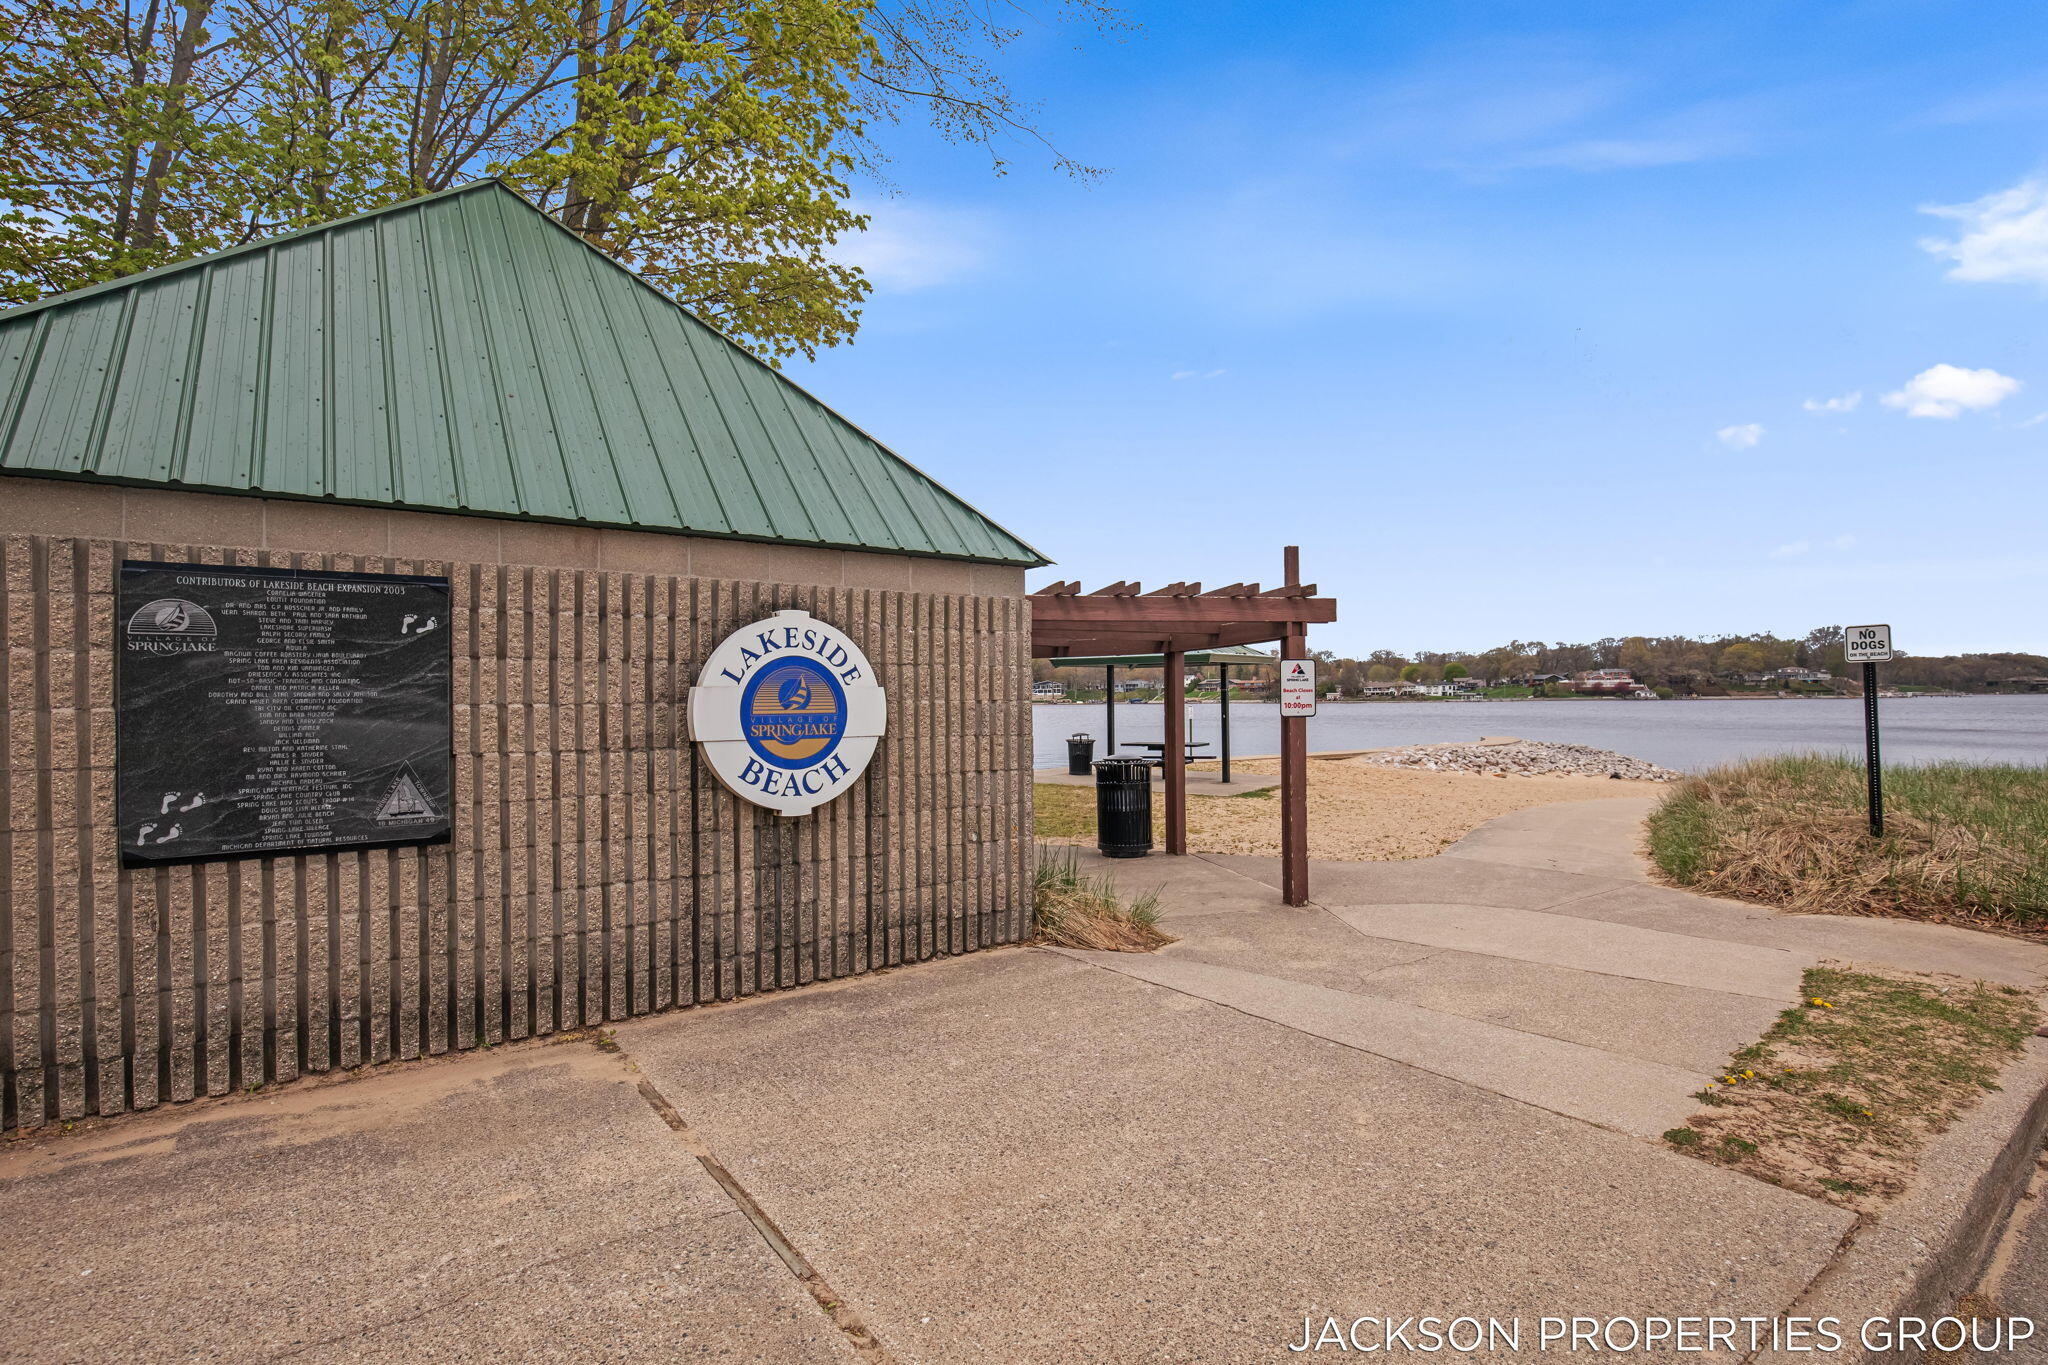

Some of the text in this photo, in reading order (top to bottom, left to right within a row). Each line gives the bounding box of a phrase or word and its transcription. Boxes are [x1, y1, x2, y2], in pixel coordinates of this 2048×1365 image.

[176, 576, 246, 588] CONTRIBUTORS
[249, 580, 260, 588] OF
[263, 580, 305, 590] LAKESIDE
[308, 582, 334, 592] BEACH
[336, 584, 380, 594] EXPANSION
[1859, 630, 1876, 640] NO
[1852, 640, 1885, 650] DOGS
[720, 627, 862, 686] LAKESIDE
[737, 752, 851, 797] BEACH
